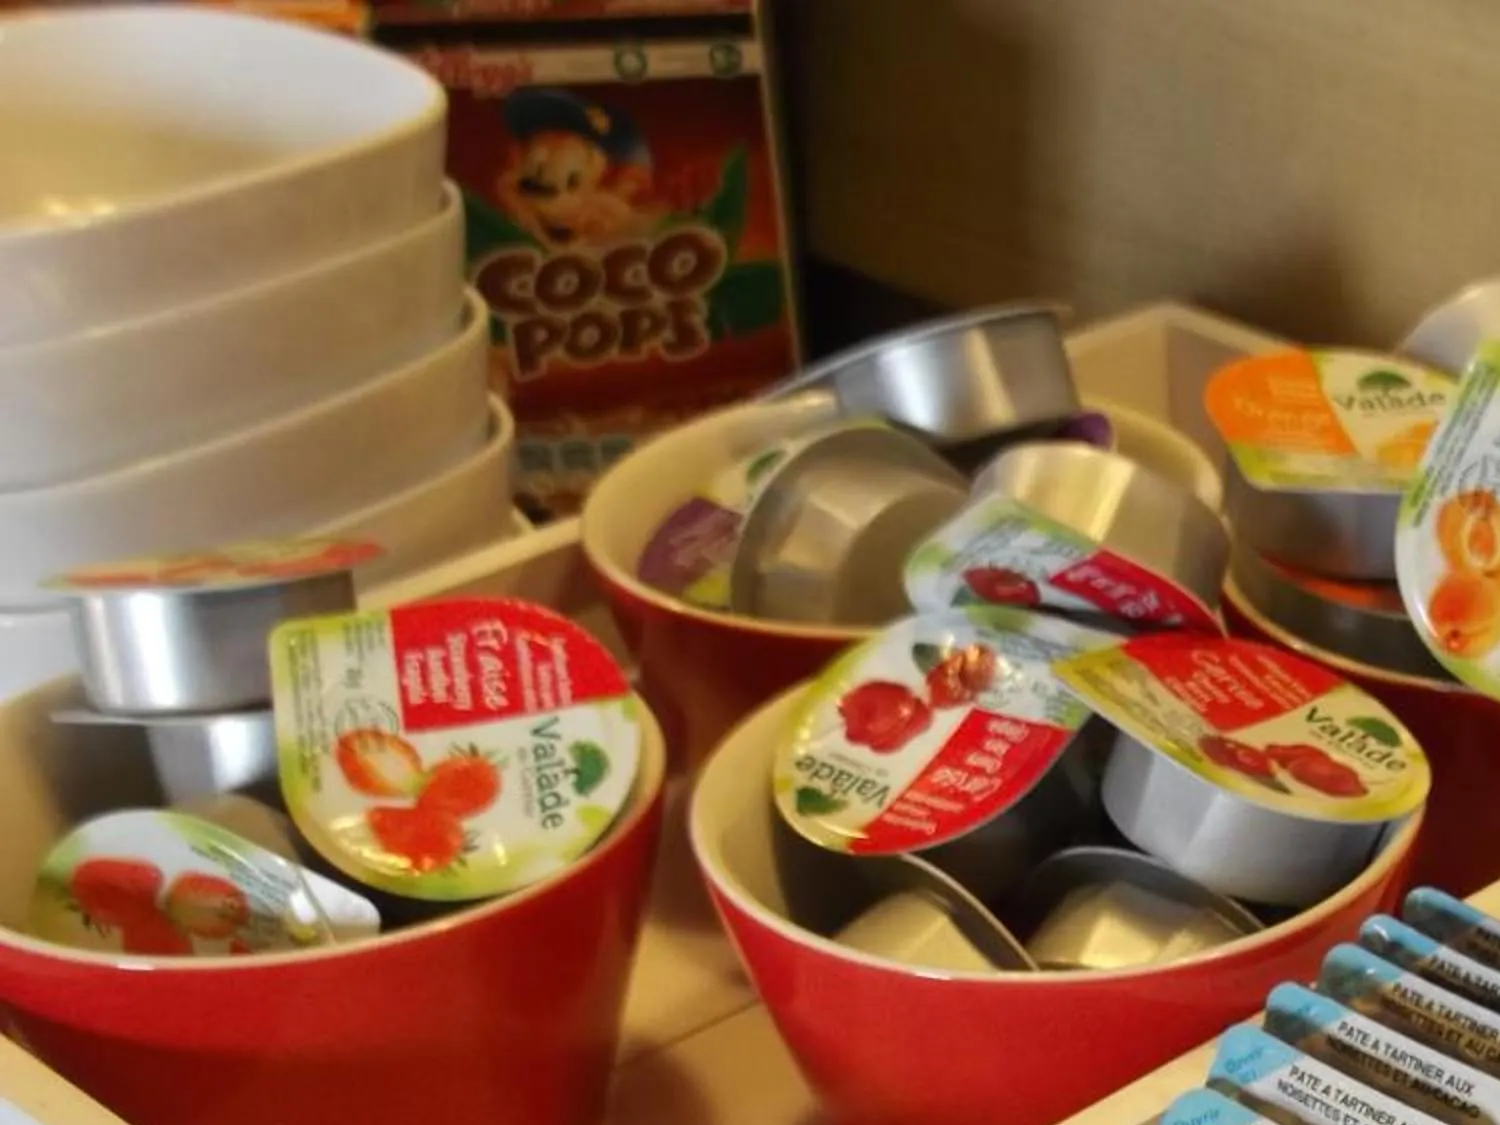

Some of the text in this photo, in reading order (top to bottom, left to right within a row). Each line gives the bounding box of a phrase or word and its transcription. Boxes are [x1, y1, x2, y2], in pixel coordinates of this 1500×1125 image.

[473, 227, 726, 317] COCO
[512, 298, 709, 380] POPS
[529, 717, 566, 830] Valade
[1304, 705, 1406, 772] Valade
[794, 753, 892, 808] Valade
[1289, 1066, 1321, 1091] PATE
[1322, 1084, 1332, 1097] A
[1338, 1021, 1370, 1047] PATE
[1371, 1036, 1384, 1049] A
[1383, 1043, 1444, 1086] TARTINER
[1446, 1074, 1475, 1096] AUX
